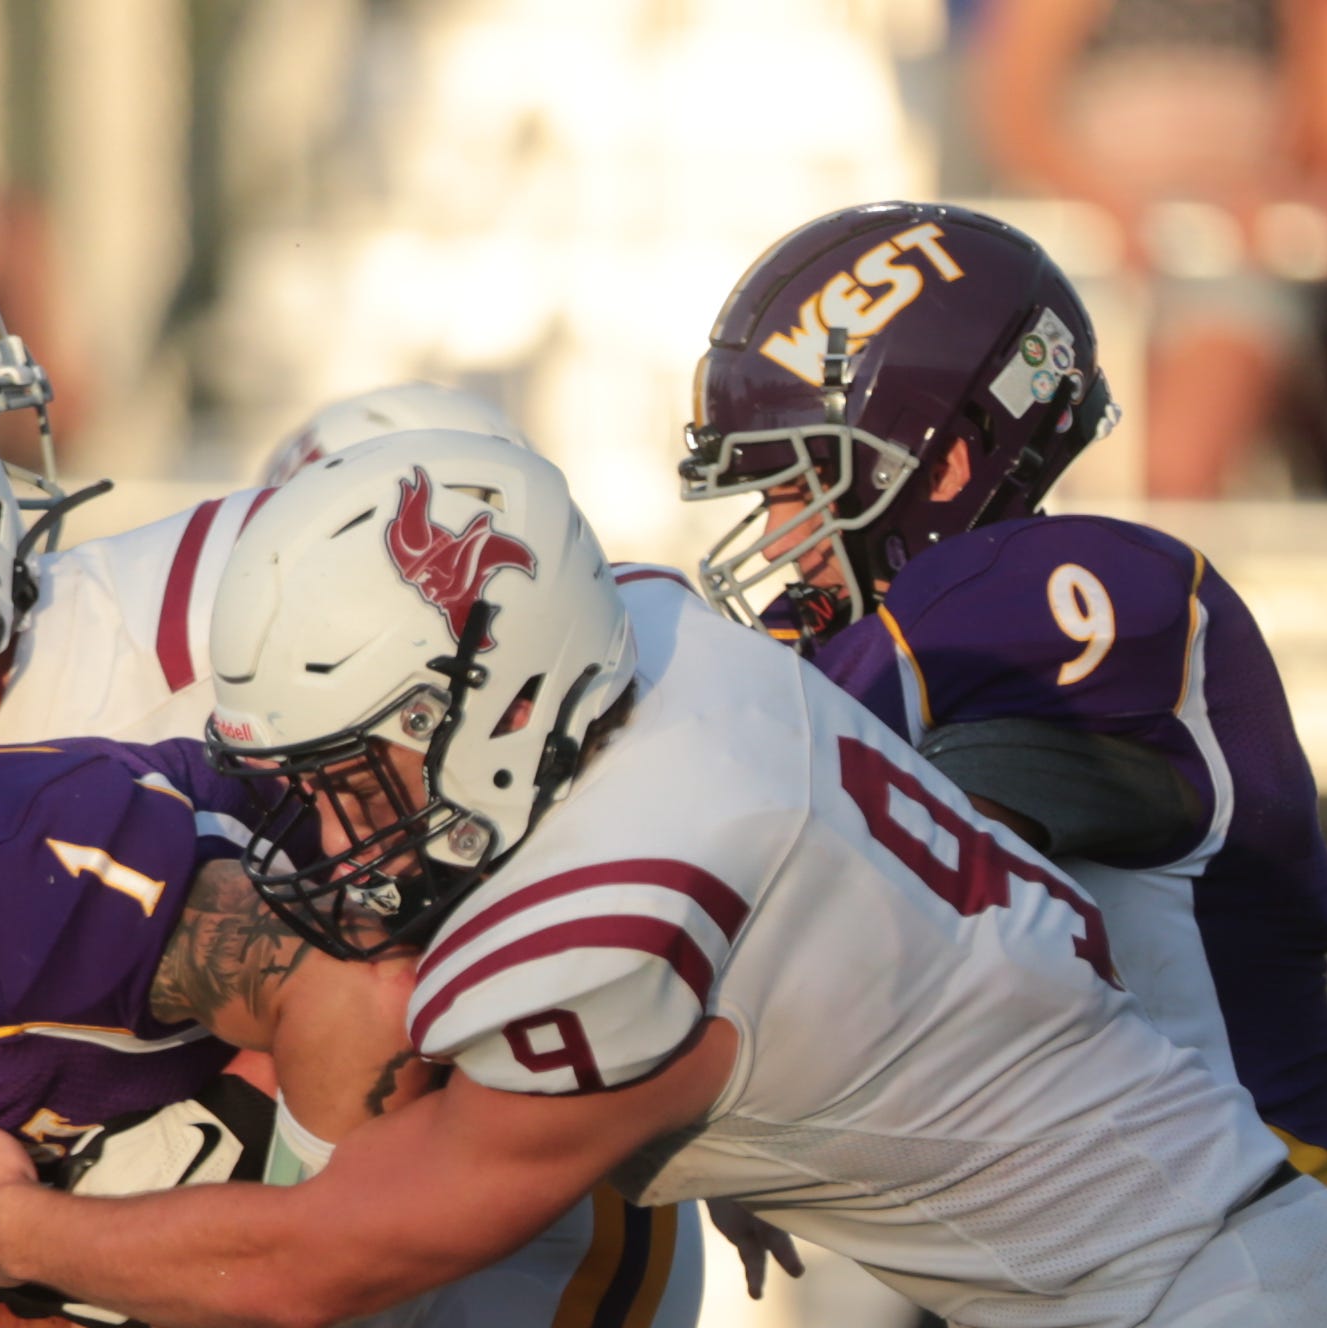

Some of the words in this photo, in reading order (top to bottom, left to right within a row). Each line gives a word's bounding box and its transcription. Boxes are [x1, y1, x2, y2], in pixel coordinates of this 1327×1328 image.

[758, 221, 966, 388] WEST
[1046, 562, 1116, 686] 9
[46, 837, 166, 917] 1
[502, 1007, 608, 1091] 9
